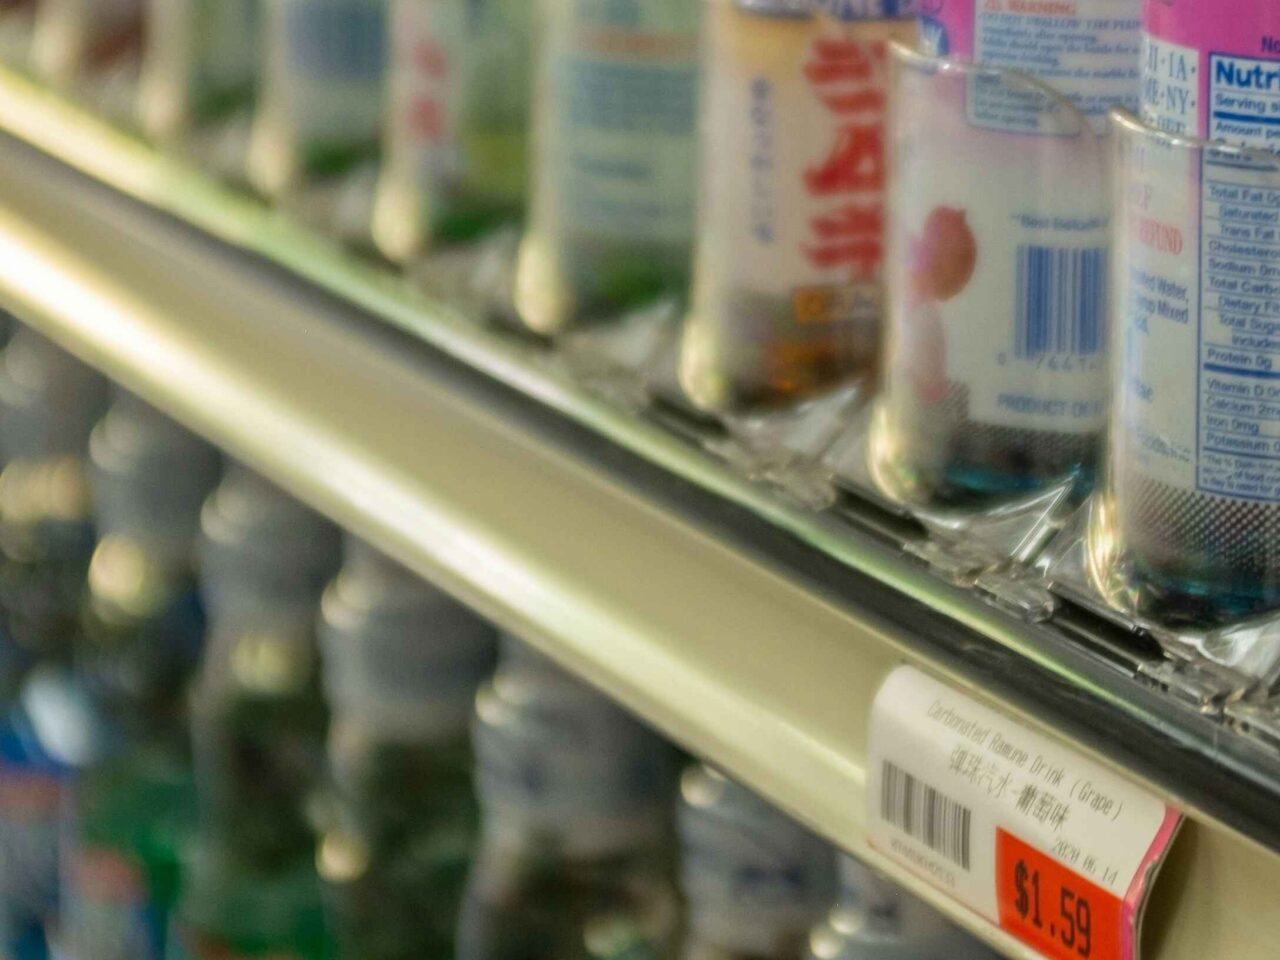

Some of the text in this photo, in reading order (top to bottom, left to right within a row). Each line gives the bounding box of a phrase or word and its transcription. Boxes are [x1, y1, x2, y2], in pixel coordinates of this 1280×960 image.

[1215, 93, 1266, 114] Serving
[1215, 120, 1262, 137] Amount
[1208, 186, 1239, 200] Total
[1241, 189, 1264, 202] Fat
[1219, 205, 1279, 223] Saturated
[1220, 224, 1252, 238] Trans
[1254, 226, 1276, 240] Fat
[1208, 257, 1256, 275] Sodium
[1208, 275, 1238, 290] Total
[1218, 294, 1261, 313] Dietary
[1219, 311, 1247, 327] Total
[1207, 348, 1273, 371] Protein 0g
[1206, 377, 1251, 396] Vitamin
[1206, 395, 1255, 414] Calcium
[1206, 414, 1229, 428] Iron
[1206, 431, 1271, 452] Potassium
[927, 699, 992, 746] Carbonated
[986, 731, 1029, 769] Ramune
[1029, 753, 1065, 788] Drink
[1014, 858, 1091, 958] $1.59
